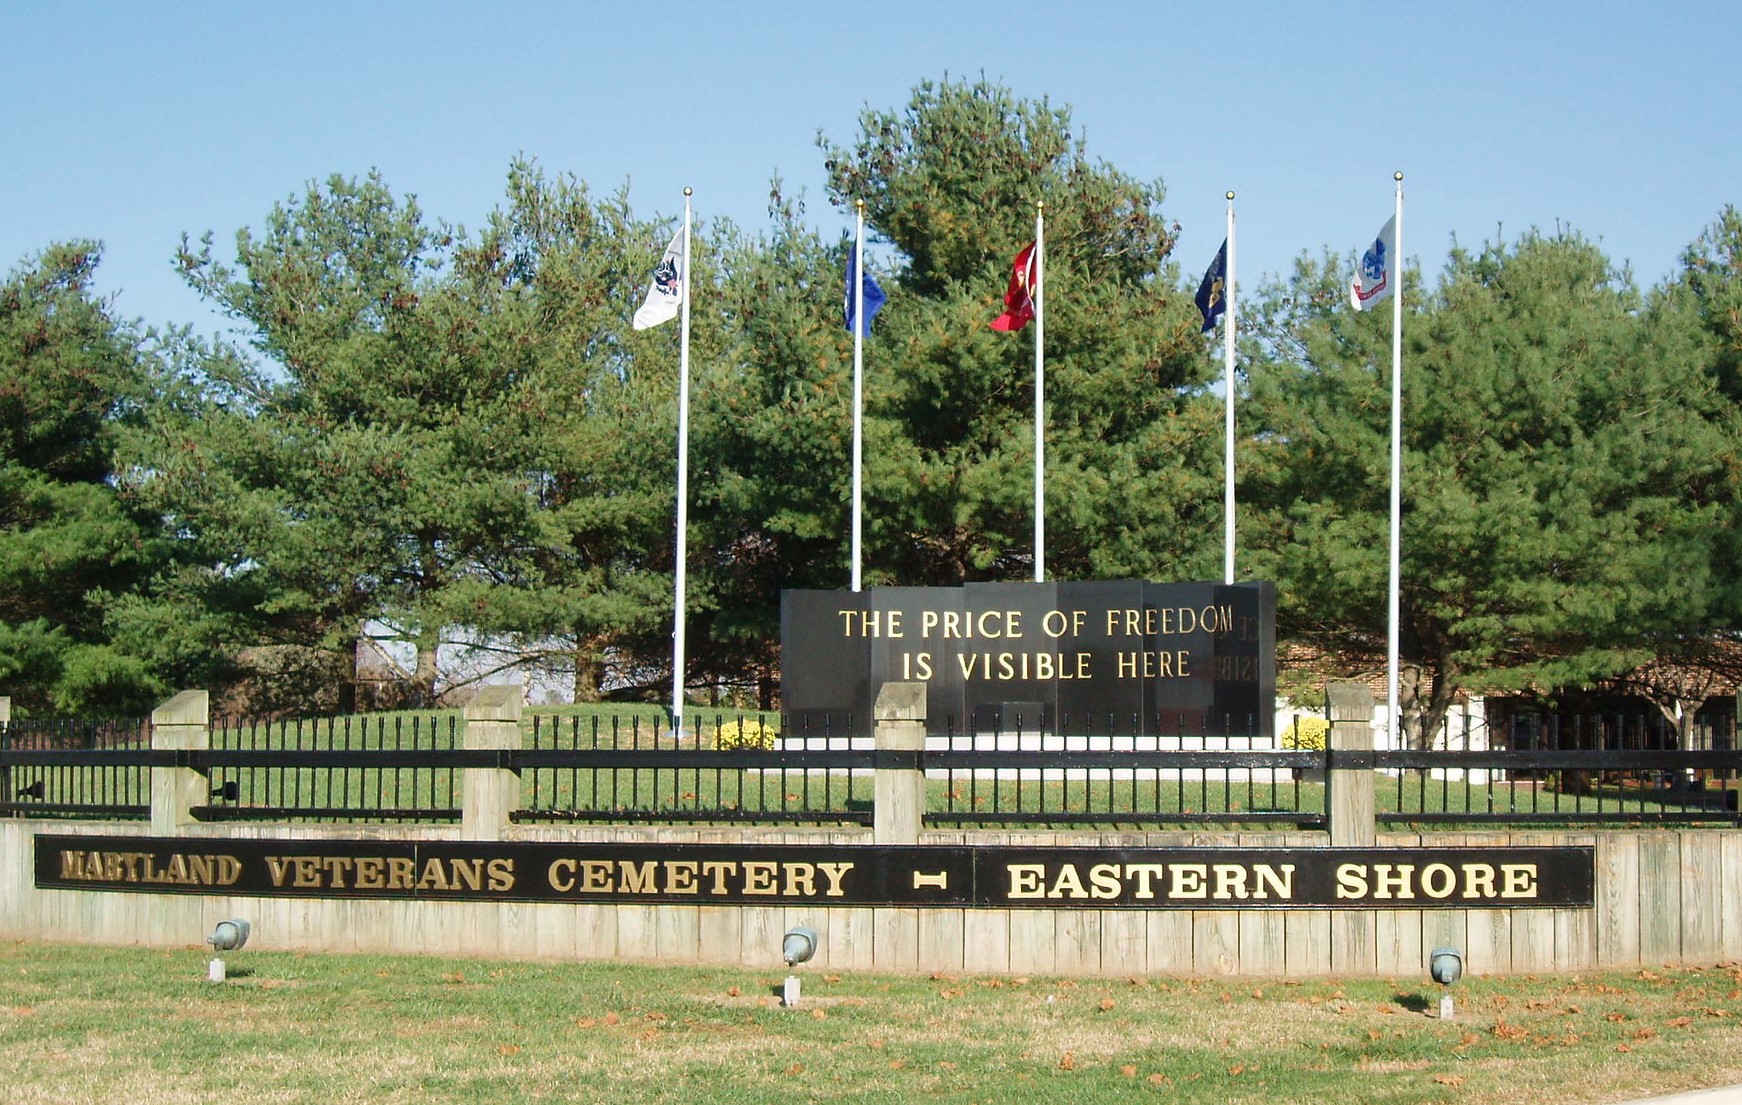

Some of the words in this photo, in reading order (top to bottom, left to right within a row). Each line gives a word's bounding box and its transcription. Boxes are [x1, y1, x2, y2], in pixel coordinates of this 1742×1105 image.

[839, 609, 903, 638] THE
[922, 610, 1023, 639] PRICE
[1043, 610, 1087, 637] OF
[1106, 605, 1234, 637] FREEDOM
[903, 652, 933, 680] IS
[957, 652, 1092, 680] VISIBLE
[1118, 650, 1190, 678] HERE
[60, 850, 242, 886] MARYLAND
[264, 856, 515, 892] VETERANS
[548, 858, 855, 897] CEMETERY
[1007, 863, 1296, 900] EASTERN
[1336, 863, 1538, 900] SHORE
